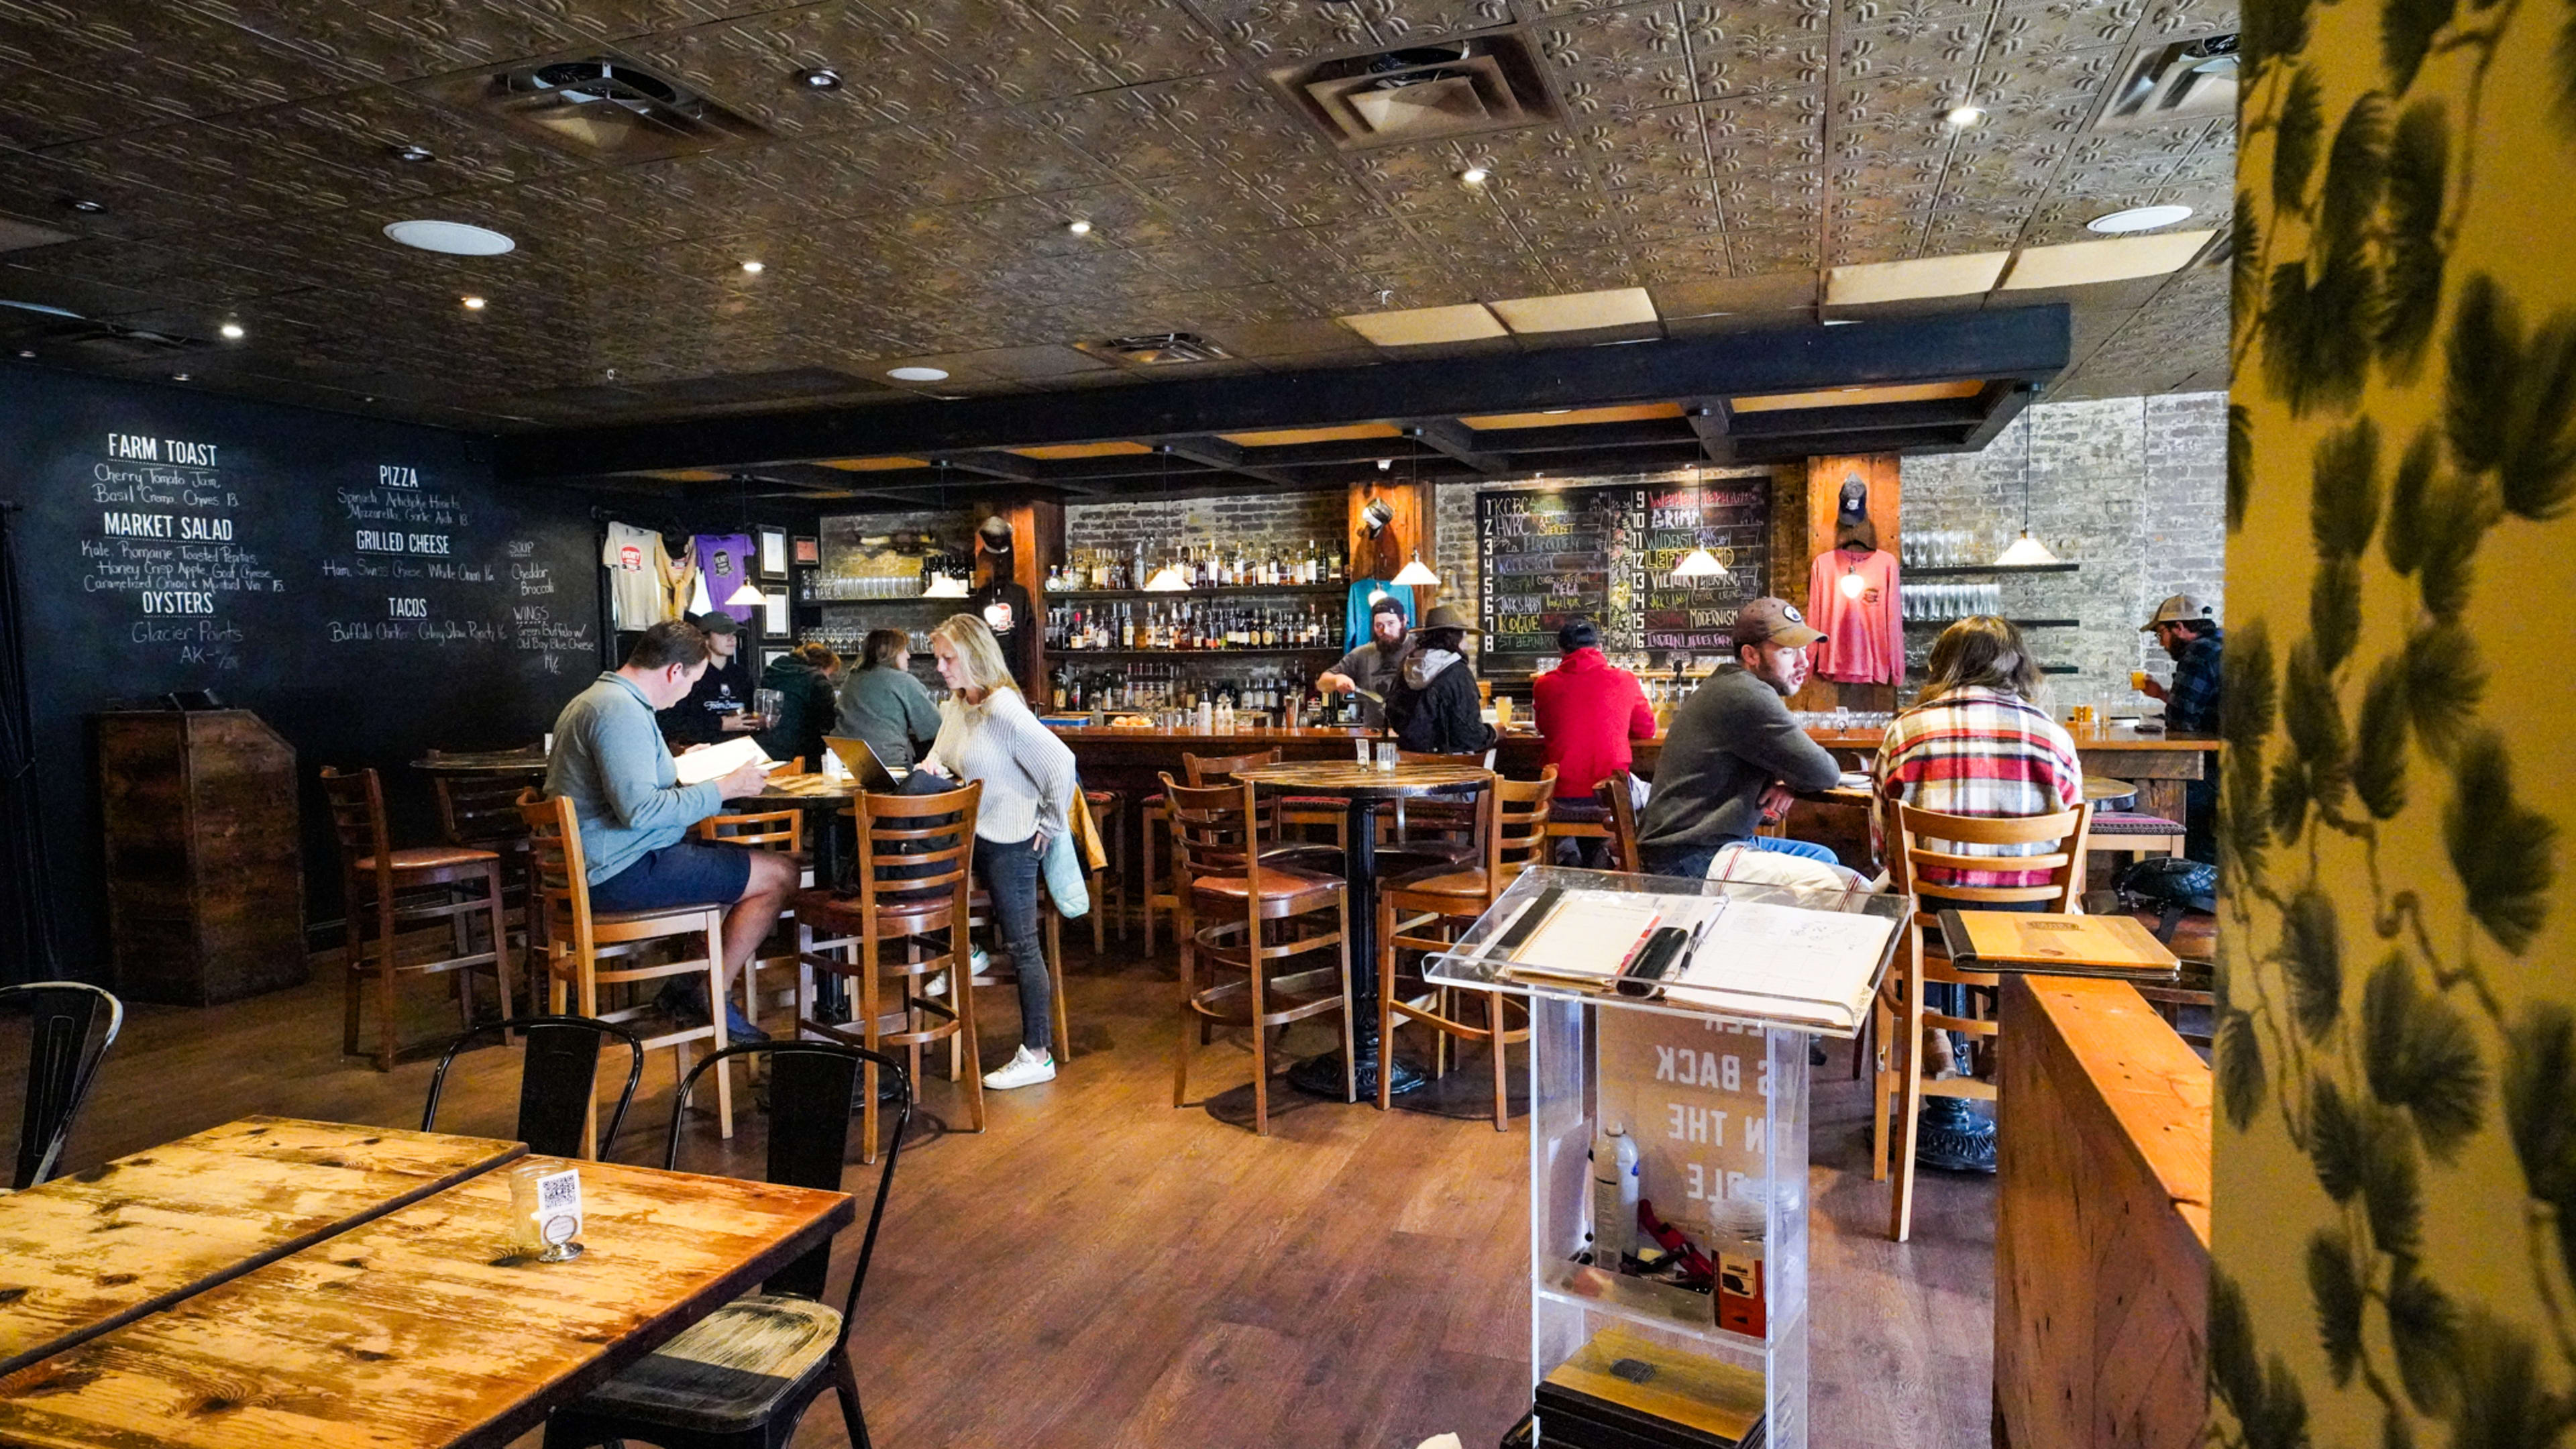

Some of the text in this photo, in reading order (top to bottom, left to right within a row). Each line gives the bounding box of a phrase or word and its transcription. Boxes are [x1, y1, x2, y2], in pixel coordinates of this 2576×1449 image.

[108, 433, 217, 466] FARM TOAST
[94, 464, 142, 491] Cherry
[140, 468, 185, 485] Tomato
[380, 465, 419, 488] PIZZA
[91, 482, 134, 503] Basil
[1636, 491, 1644, 508] 9
[1485, 499, 1492, 515] 1
[104, 512, 232, 541] MARKET SALAD
[1485, 519, 1493, 535] 2
[1632, 513, 1645, 528] 10
[356, 530, 450, 555] GRILLED CHEESE
[508, 541, 534, 554] SOUP
[1485, 539, 1493, 555] 3
[1631, 532, 1643, 549] 11
[176, 545, 219, 562] Toasted
[1632, 552, 1644, 570] 12
[96, 560, 140, 580] Honey
[144, 561, 173, 578] Crisp
[213, 564, 235, 579] Goat
[511, 563, 548, 580] Cheddar
[1485, 558, 1493, 574] 4
[84, 575, 152, 592] Caramelized
[156, 576, 188, 590] Onion
[521, 578, 554, 596] Broccoli
[1485, 577, 1493, 594] 5
[1632, 572, 1645, 590] 13
[142, 591, 214, 613] OYSTERS
[388, 598, 427, 617] TACOS
[1485, 596, 1493, 614] 6
[1632, 592, 1645, 609] 14
[513, 606, 549, 621] WINGS
[1632, 612, 1645, 629] 15
[1690, 609, 1738, 629] MODERNISM
[131, 621, 193, 643] Glacier
[327, 621, 372, 643] Buffalo
[1485, 616, 1493, 633] 7
[1498, 613, 1540, 634] ROGUE
[1485, 635, 1493, 652] 8
[1632, 633, 1645, 649] 16
